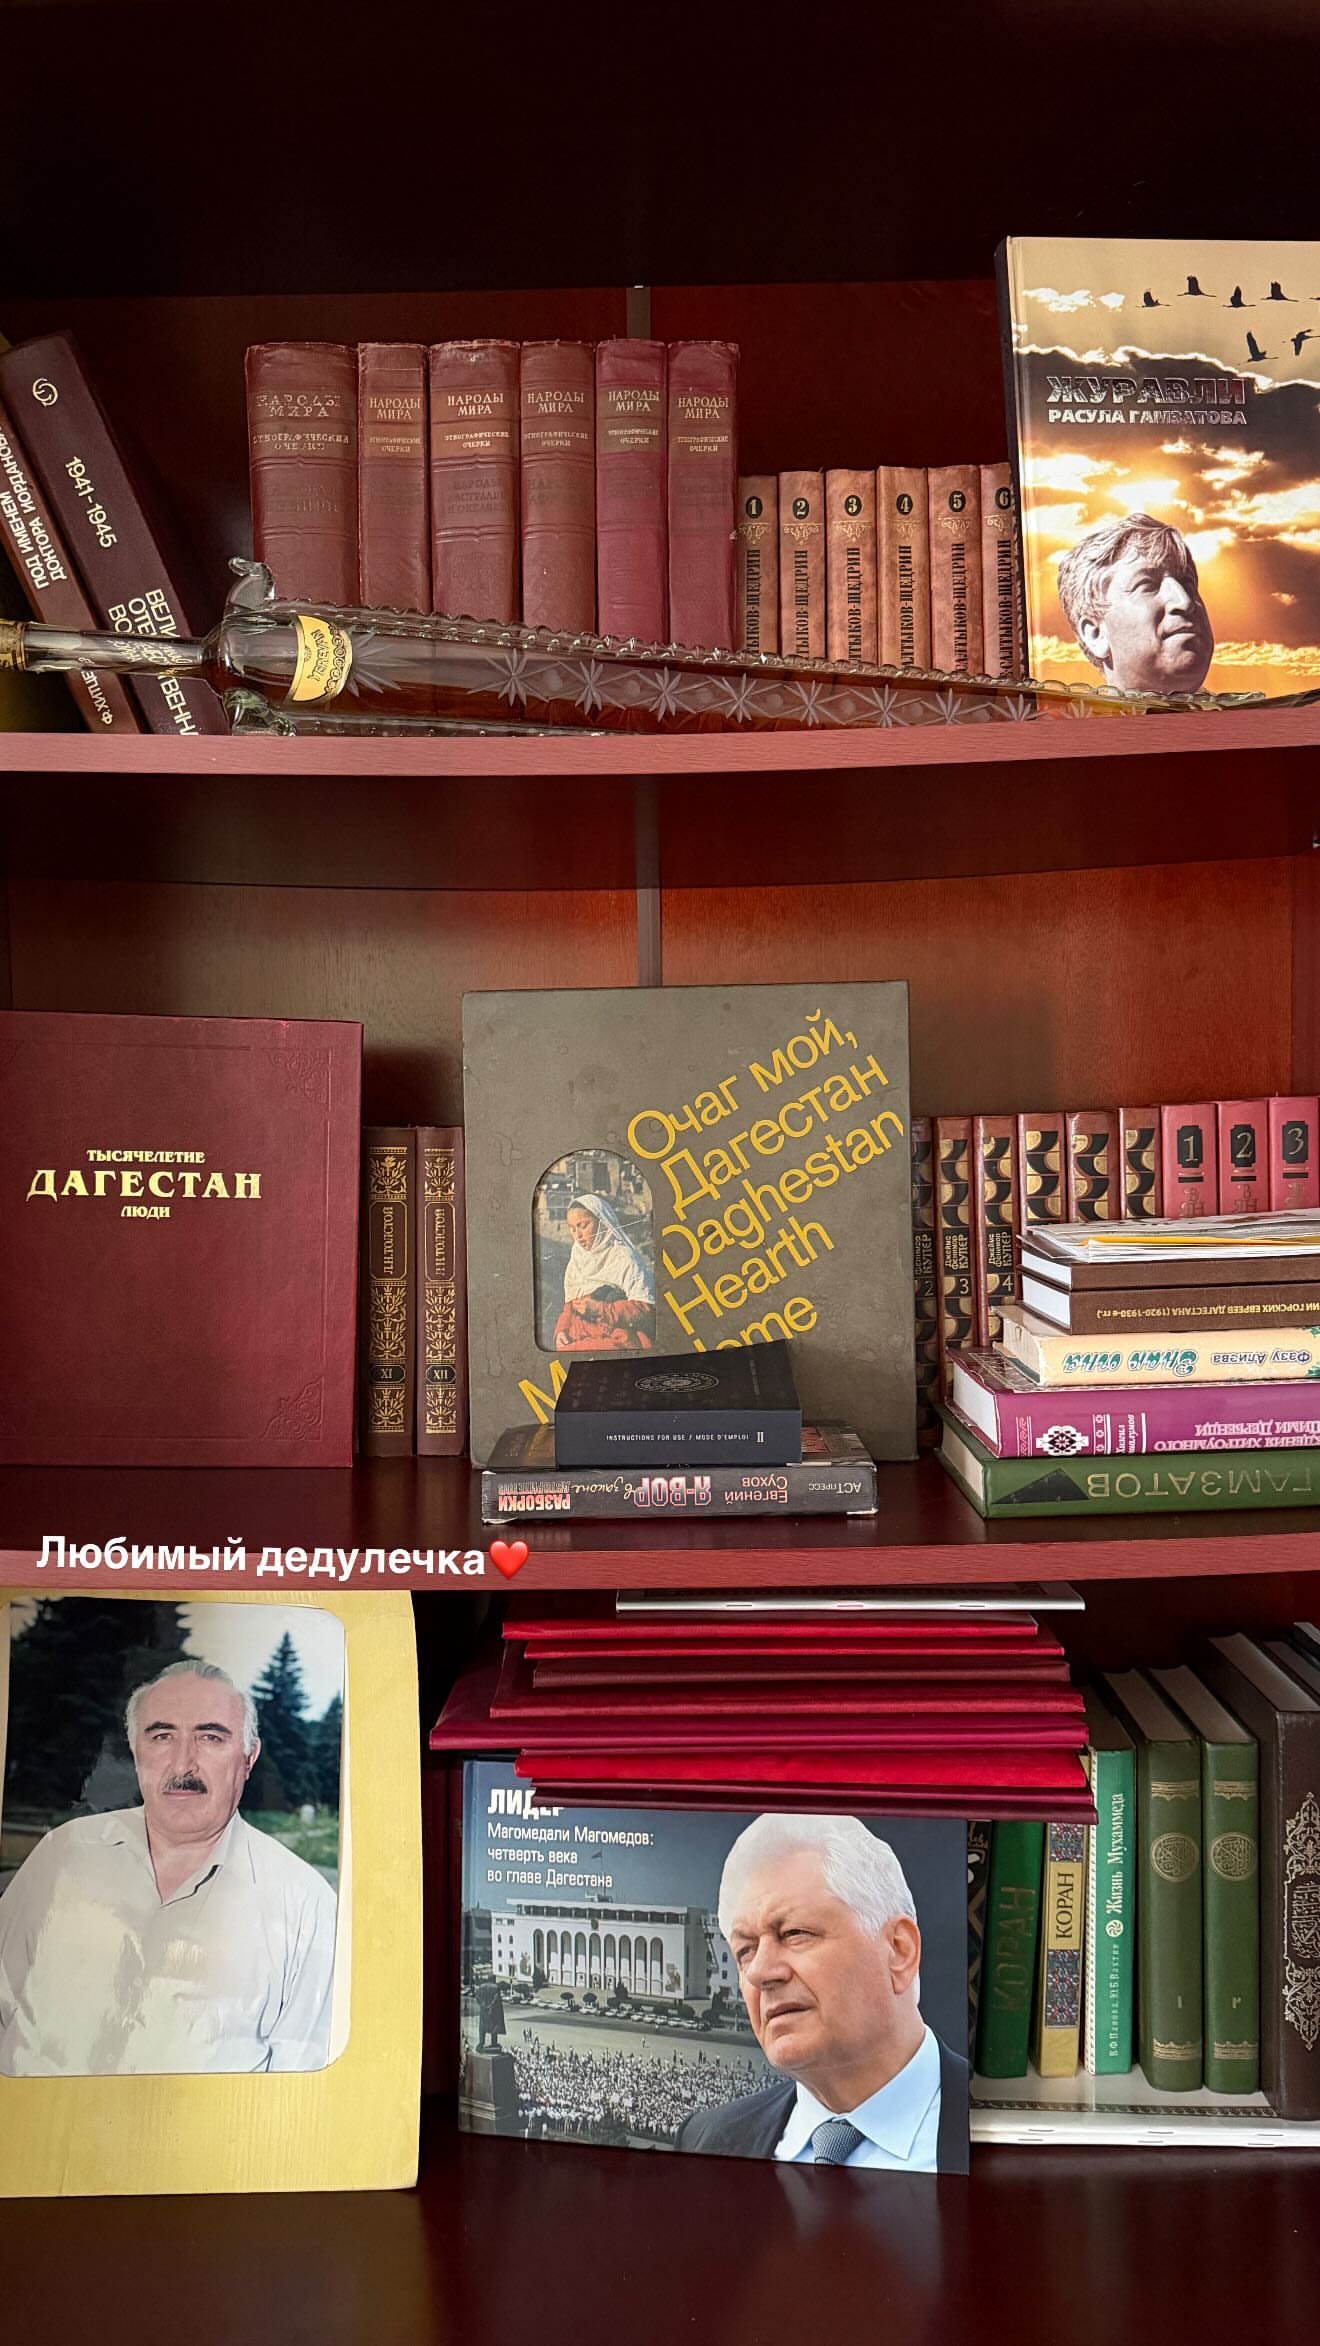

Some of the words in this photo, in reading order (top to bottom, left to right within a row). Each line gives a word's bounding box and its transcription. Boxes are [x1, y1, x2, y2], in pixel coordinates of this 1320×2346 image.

[527, 391, 584, 403] НАРОДЫ
[608, 390, 660, 401] НАРОДЫ
[1046, 376, 1247, 405] ЖУРАВЛИ
[370, 398, 420, 409] НАРОДЫ
[447, 393, 504, 406] НАРОДЫ
[538, 403, 573, 413] МИРА
[616, 401, 651, 412] МИРА
[678, 397, 729, 408] НАРОДЫ
[377, 409, 412, 420] МИРА
[457, 405, 492, 416] МИРА
[685, 408, 720, 419] МИРА
[1048, 409, 1125, 424] РАСУЛА
[1129, 410, 1248, 425] ГАМЗАТОВА
[444, 432, 510, 441] ЭТНОГРАФИЧЕСКИЕ
[462, 440, 491, 449] ОЧЕРКИ
[0, 425, 36, 513] ИОРДАНОВ
[65, 456, 118, 548] 1941-1945
[748, 499, 759, 515] 1
[848, 497, 858, 513] 3
[900, 496, 909, 513] 4
[952, 493, 962, 509] 5
[999, 491, 1009, 507] 6
[796, 501, 806, 516] 2
[0, 491, 34, 554] ИМЕНЕМ
[29, 517, 68, 580] ДОКТОРА
[25, 555, 49, 589] ПОД
[746, 549, 761, 654] ТЫКОВ-ЩЕДРИН
[794, 550, 810, 657] ТЫКОВ-ЩЕДРИН
[847, 547, 863, 661] ЛТЫКОВ-ЩЕДРИН
[898, 545, 915, 667] АЛТЫКОВ-ЩЕДРИН
[626, 1074, 739, 1160] Очаг
[749, 1008, 859, 1092] мой,
[660, 1055, 889, 1222] Дагестан
[1236, 1132, 1253, 1158] 2
[1288, 1127, 1304, 1155] 3
[87, 1149, 206, 1164] ТЫСЯЧЕЛЕТИЕ
[1183, 1135, 1198, 1162] 1
[25, 1169, 262, 1203] ДАГЕСТАН
[661, 1108, 906, 1280] Daghestan
[120, 1205, 171, 1220] ЛЮДИ
[922, 1233, 933, 1274] КУПЕР
[958, 1233, 969, 1270] КУПЕР
[1002, 1231, 1013, 1267] КУПЕР
[663, 1217, 835, 1335] Hearth
[1002, 1275, 1013, 1292] 4
[924, 1281, 934, 1296] 2
[960, 1278, 969, 1294] 3
[1173, 1304, 1227, 1317] ДАГЕСТАНА
[1228, 1304, 1261, 1314] ЕВРЕЕВ
[1262, 1303, 1305, 1313] ГОРСКИХ
[694, 1296, 818, 1352] ome
[1211, 1351, 1266, 1365] Алиева
[1270, 1350, 1312, 1364] Фазу
[380, 1368, 393, 1381] XI
[433, 1368, 448, 1381] XII
[606, 1434, 655, 1442] INSTRUCTIONS
[717, 1433, 749, 1441] D'EMPLOI
[1154, 1437, 1262, 1452] ХИТРОУМНОГО
[571, 1475, 624, 1494] законе
[742, 1474, 788, 1490] Сухов
[1087, 1468, 1313, 1498] ГАМЗАТОВ
[633, 1476, 712, 1508] Я-ВОР
[725, 1490, 788, 1505] Евгений
[498, 1494, 571, 1512] РАЗБОРКИ
[487, 1823, 570, 1842] Магомедали
[574, 1825, 655, 1848] Магомедов:
[1107, 1792, 1128, 1865] Мухаммеда
[487, 1848, 545, 1866] четверть
[549, 1850, 578, 1864] века
[487, 1869, 502, 1882] во
[506, 1870, 542, 1884] главе
[546, 1868, 613, 1888] Дагестана
[1106, 1871, 1124, 1914] Жизнь
[1055, 1871, 1075, 1941] КОРАН
[993, 1885, 1037, 2013] КОРАН
